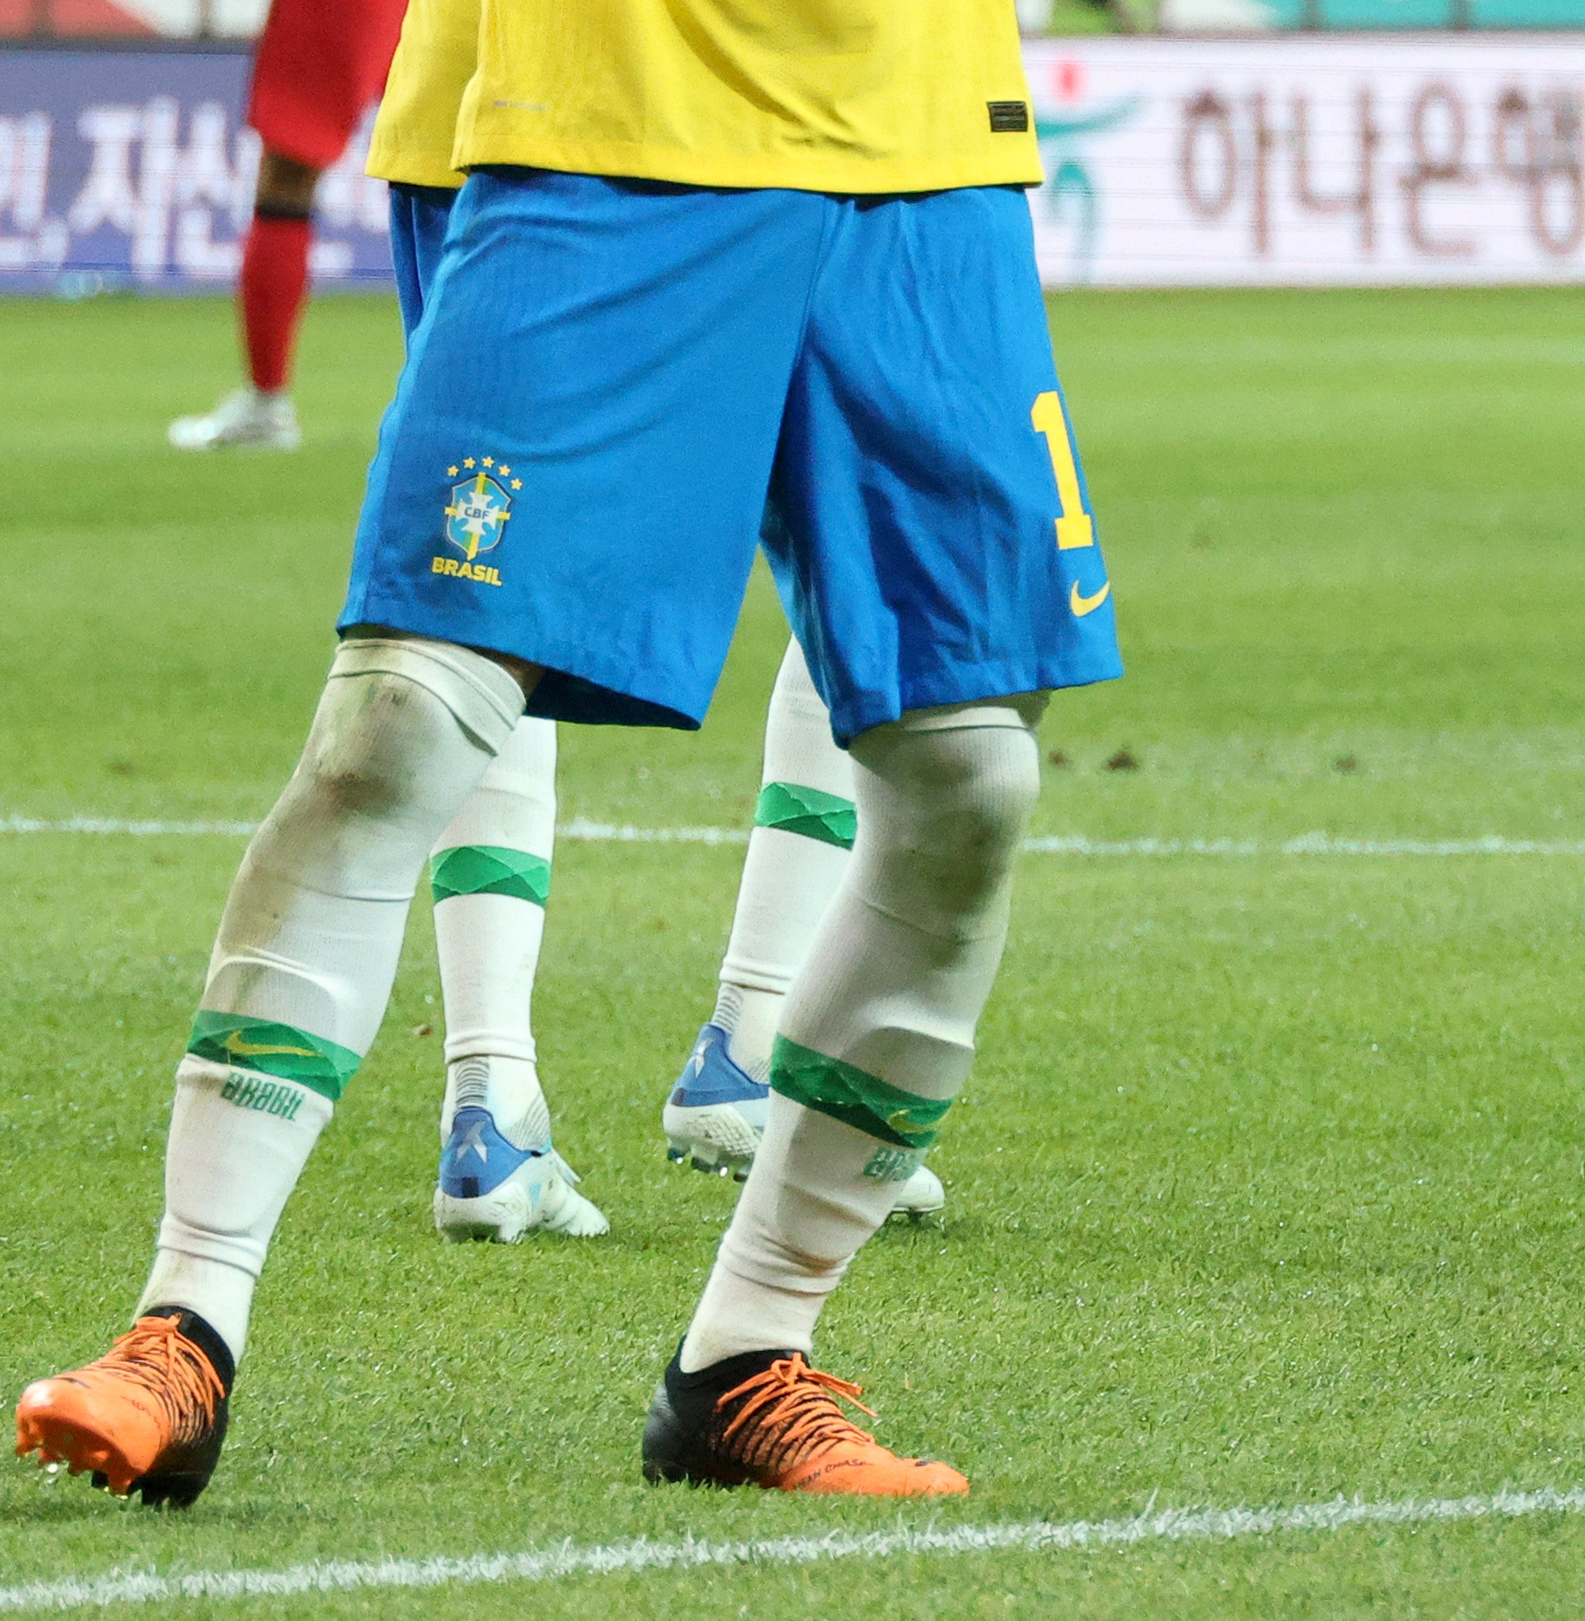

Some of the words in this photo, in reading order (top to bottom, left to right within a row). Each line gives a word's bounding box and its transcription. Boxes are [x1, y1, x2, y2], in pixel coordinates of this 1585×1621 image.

[68, 93, 388, 281] 자산
[464, 506, 491, 521] CBF
[1030, 390, 1094, 550] 1
[431, 556, 503, 587] BRASIL
